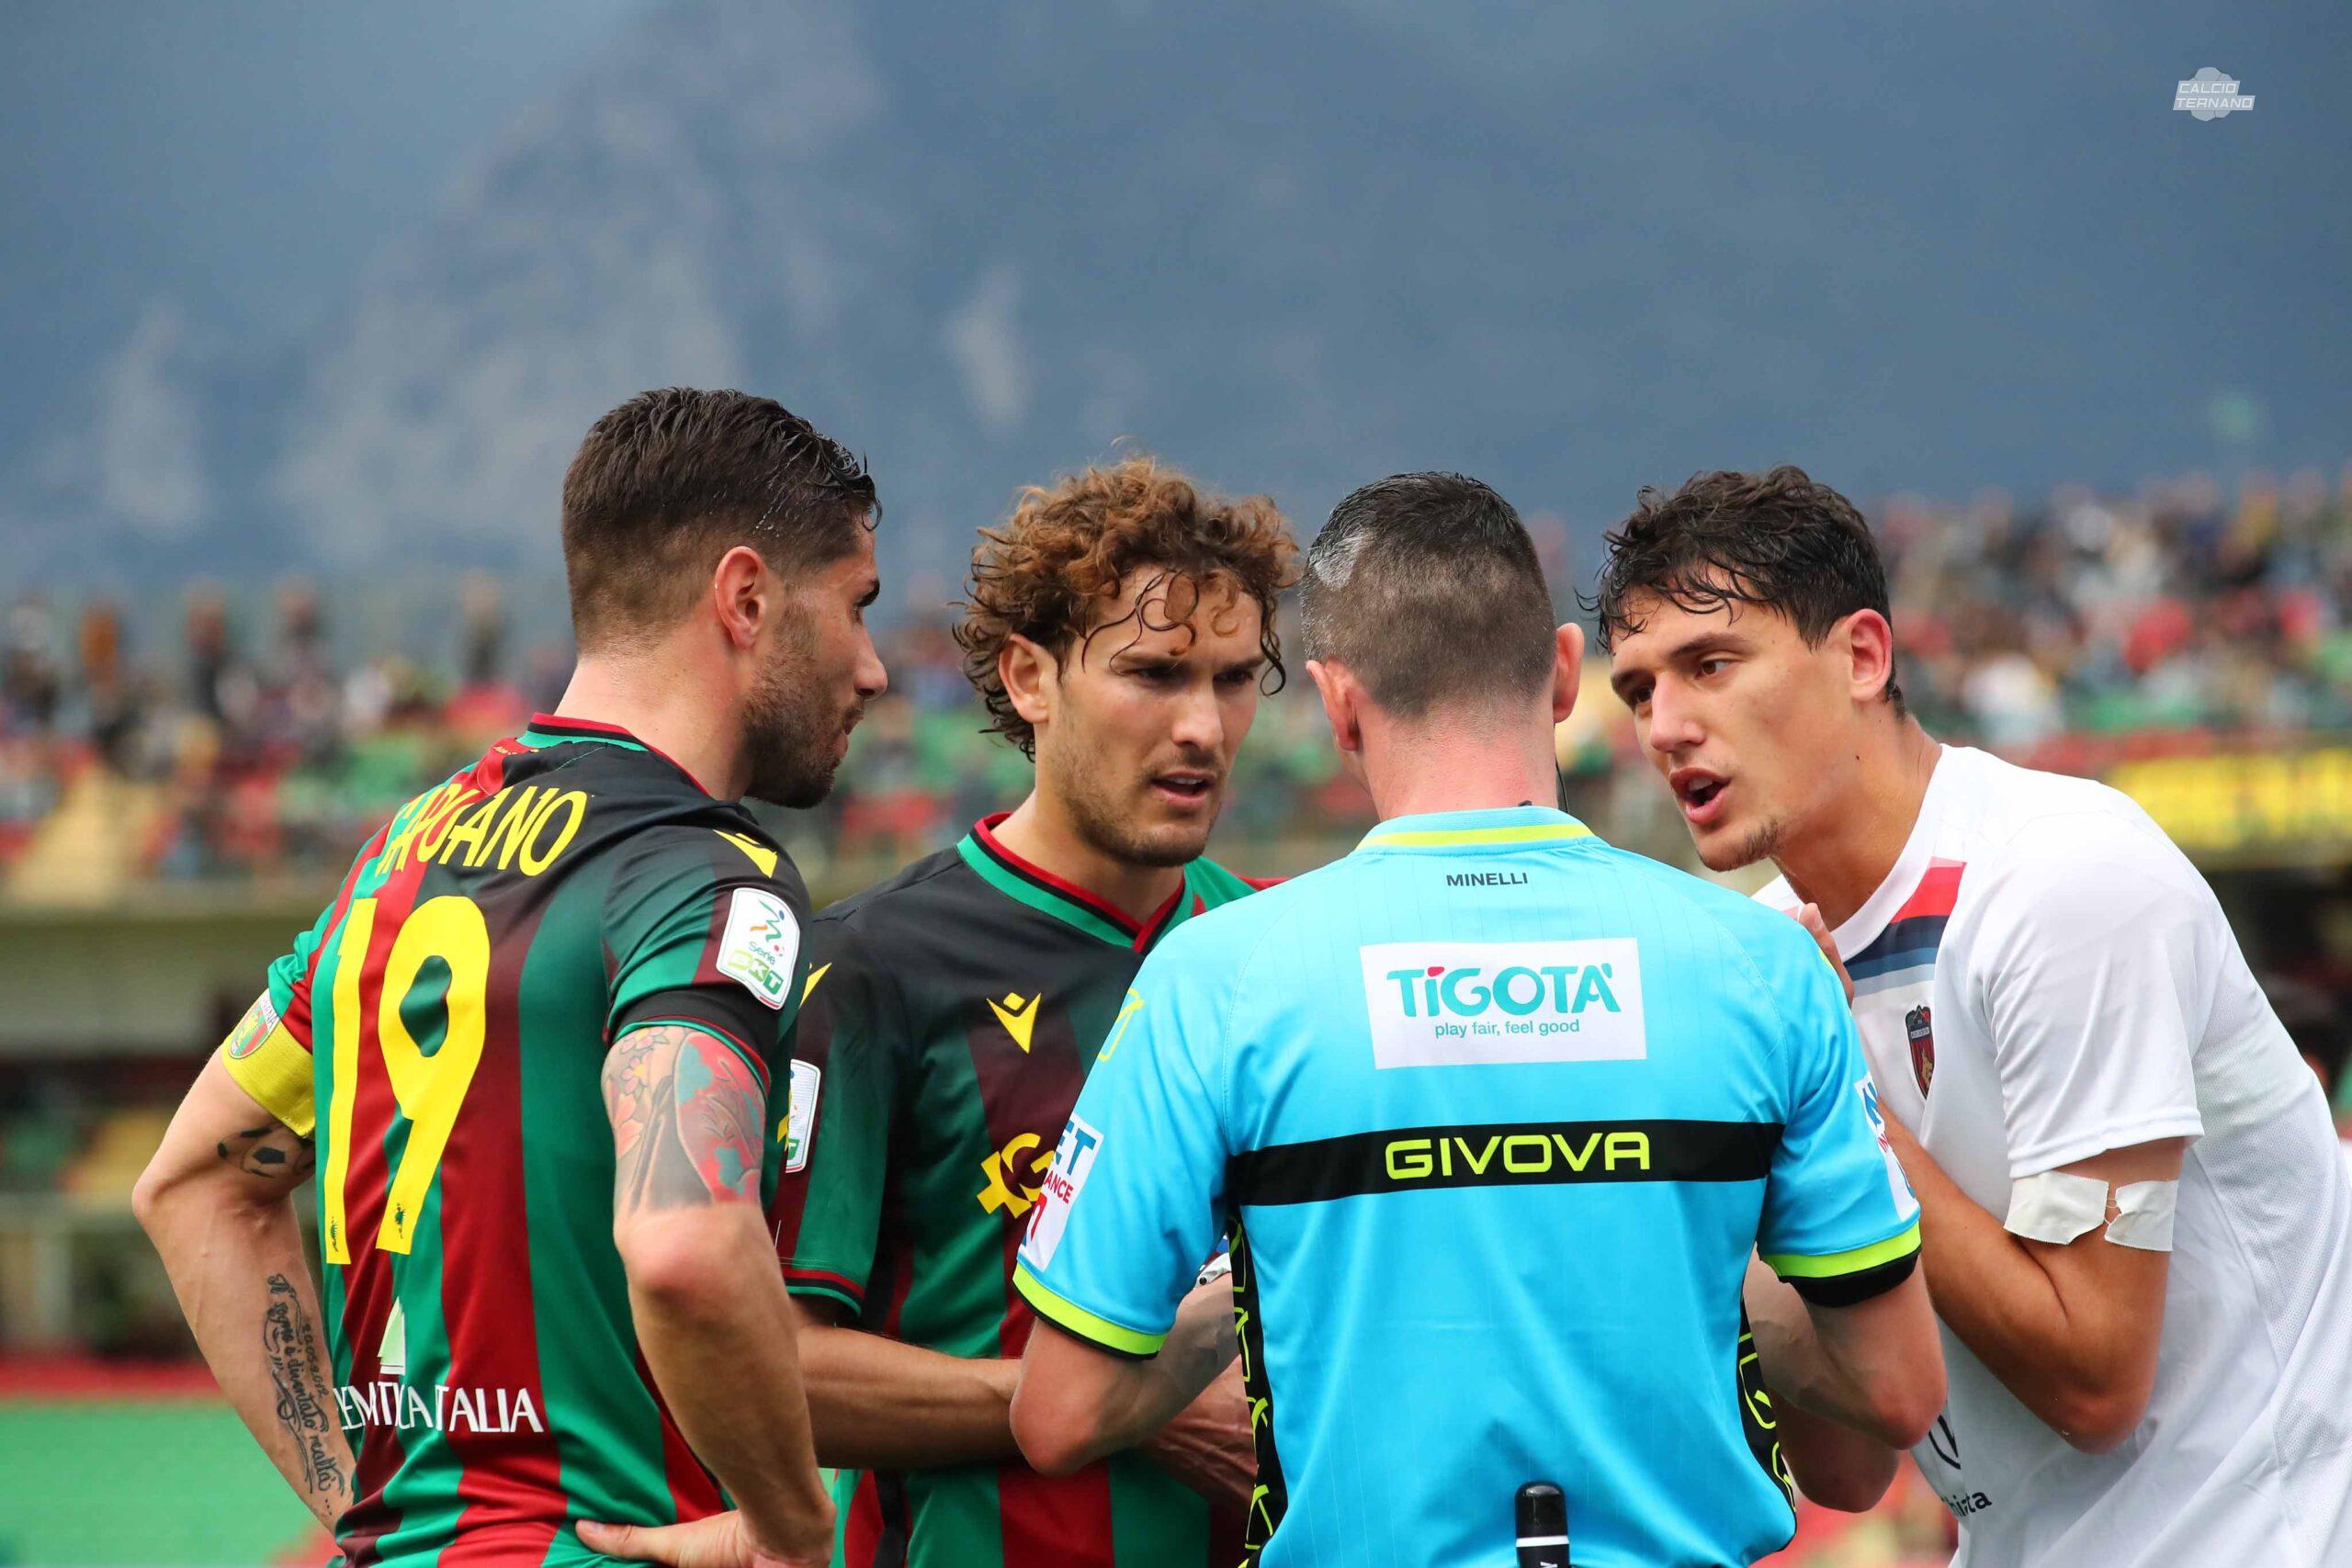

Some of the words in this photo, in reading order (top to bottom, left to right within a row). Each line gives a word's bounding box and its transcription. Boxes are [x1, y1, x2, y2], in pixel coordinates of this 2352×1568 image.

[1445, 872, 1529, 887] MINELLI
[1434, 1022, 1468, 1039] play
[1472, 1021, 1500, 1037] fair,
[1505, 1020, 1534, 1034] feel
[1538, 1018, 1580, 1036] good
[324, 895, 491, 1265] 19
[1385, 1131, 1651, 1180] GIVOVA
[1043, 1169, 1074, 1205] ANCE
